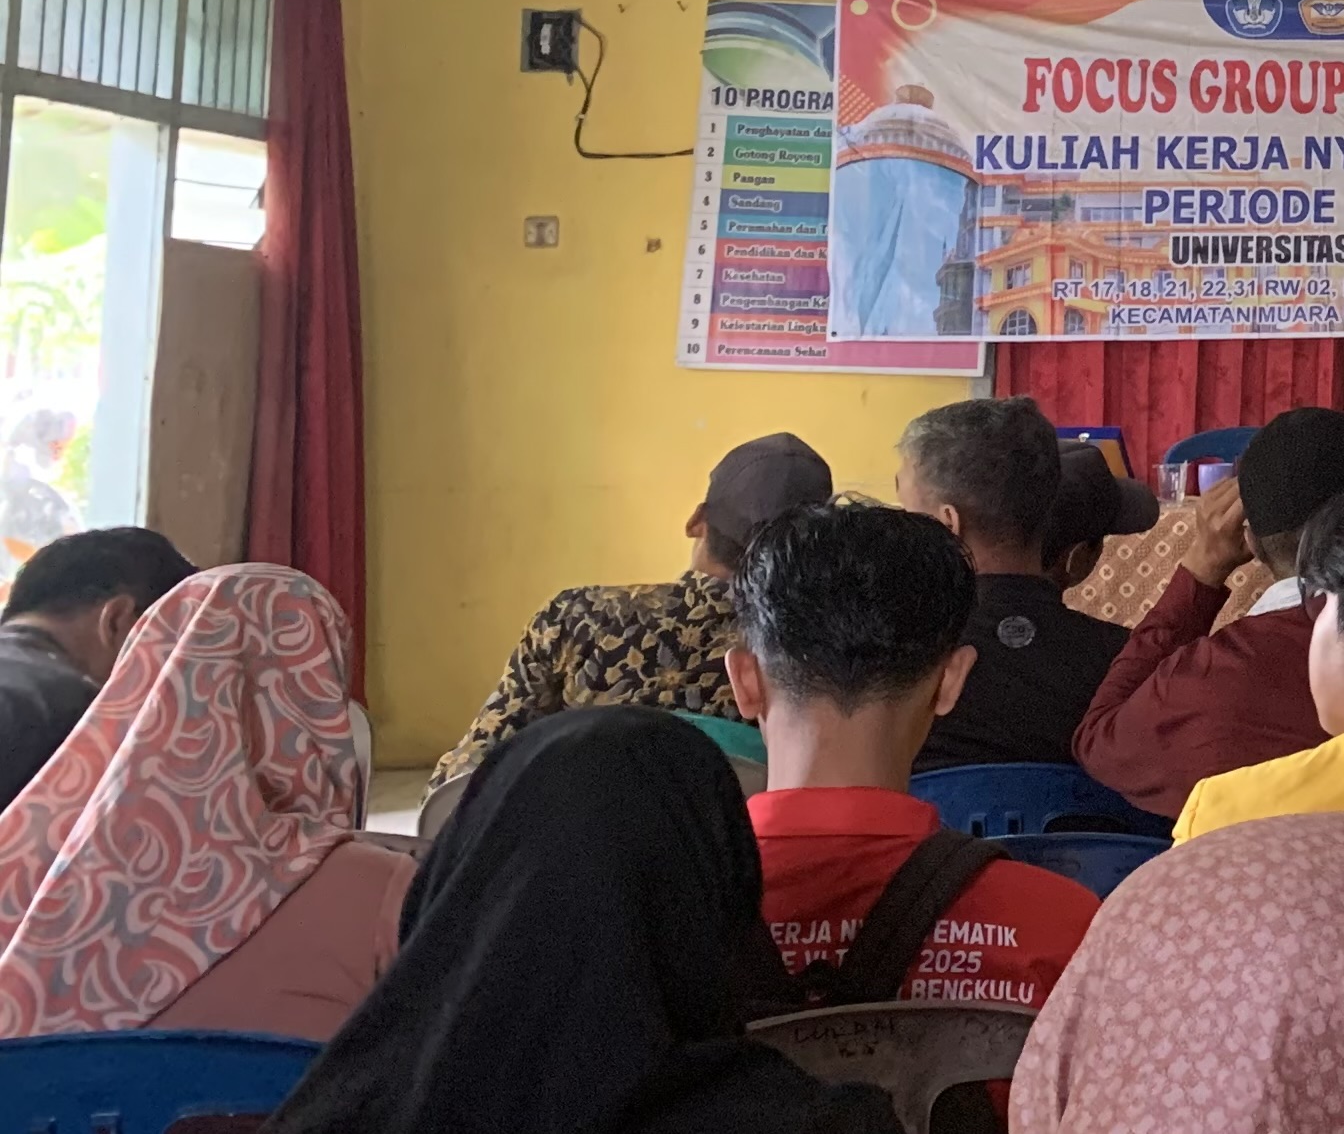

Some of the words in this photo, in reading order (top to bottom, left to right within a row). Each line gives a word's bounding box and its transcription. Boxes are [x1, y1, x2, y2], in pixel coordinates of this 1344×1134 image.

[1022, 56, 1177, 114] FOCUS
[712, 86, 738, 106] 10
[746, 88, 833, 110] PROGRA
[707, 147, 714, 157] 2
[735, 148, 775, 162] Gotong
[779, 150, 820, 163] Royong
[975, 134, 1139, 172] KULIAH
[1157, 135, 1289, 171] KERJA
[705, 171, 712, 182] 3
[733, 172, 775, 185] Pangan
[702, 196, 710, 206] 4
[731, 197, 781, 211] Sandang
[1144, 188, 1335, 225] PERIODE
[700, 220, 707, 230] 5
[728, 221, 792, 233] Perumahan
[796, 224, 817, 234] dan
[698, 244, 705, 255] 6
[726, 246, 790, 258] Pendidikan
[794, 248, 814, 259] dan
[697, 269, 703, 279] 7
[724, 270, 783, 282] Kesehatan
[1054, 281, 1083, 298] RT
[1090, 281, 1121, 301] 17,
[1129, 280, 1158, 300] 18,
[1164, 280, 1195, 300] 21,
[1202, 280, 1257, 300] 22,31
[1266, 279, 1300, 296] RW
[1307, 279, 1337, 299] 02,
[693, 294, 701, 304] 8
[722, 295, 809, 310] Pengembangan
[1111, 306, 1250, 325] KECAMATAN
[1259, 306, 1339, 324] MUARA
[691, 318, 699, 329] 9
[788, 322, 826, 333] Lingku
[687, 343, 700, 354] 10
[718, 344, 791, 356] Perencanaan
[795, 346, 826, 357] Sehat
[770, 919, 831, 946] ERJA
[933, 919, 1018, 948] EMATIK
[918, 949, 983, 974] 2025
[911, 979, 1036, 1004] BENGKULU
